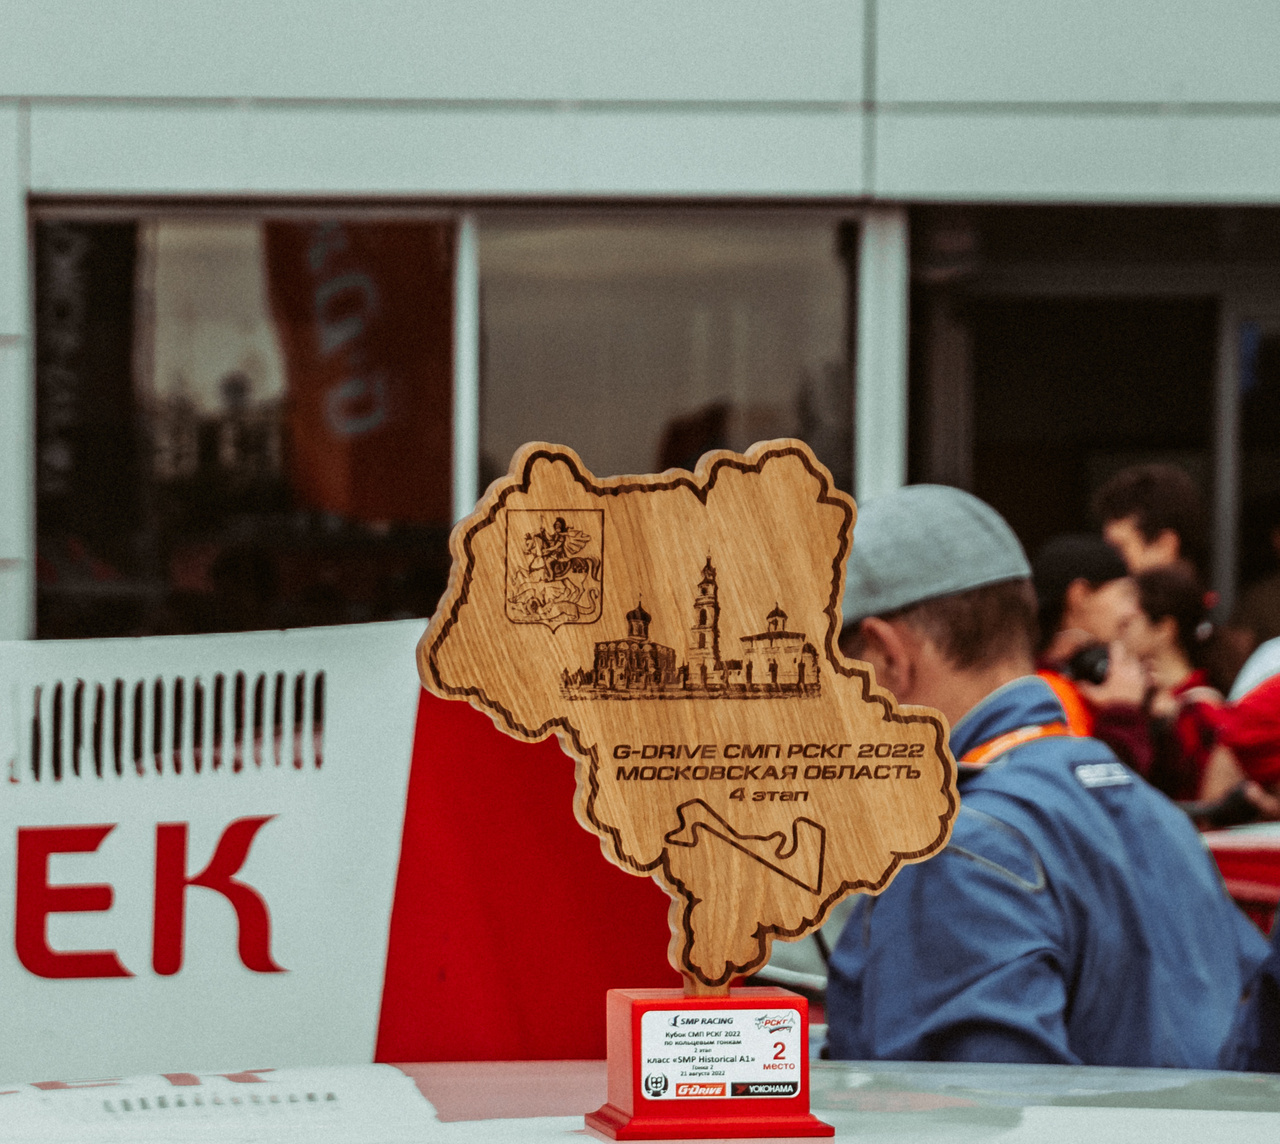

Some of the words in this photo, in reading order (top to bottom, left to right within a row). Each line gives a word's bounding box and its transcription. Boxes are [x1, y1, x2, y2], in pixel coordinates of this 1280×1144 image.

[613, 744, 718, 760] G-DRIVE
[723, 743, 782, 759] СМП
[787, 743, 852, 759] РСКГ
[857, 743, 926, 759] 2022
[616, 764, 799, 781] МОСКОВСКАЯ
[803, 764, 922, 780] ОБЛАСТЬ
[729, 786, 746, 802] 4
[751, 789, 810, 802] этап
[700, 1017, 734, 1025] RACING
[665, 1031, 686, 1039] Кубок
[773, 1041, 787, 1060] 2
[672, 1055, 697, 1063] «SMP
[698, 1055, 737, 1063] Historical
[748, 1084, 794, 1093] YOKOHAMA
